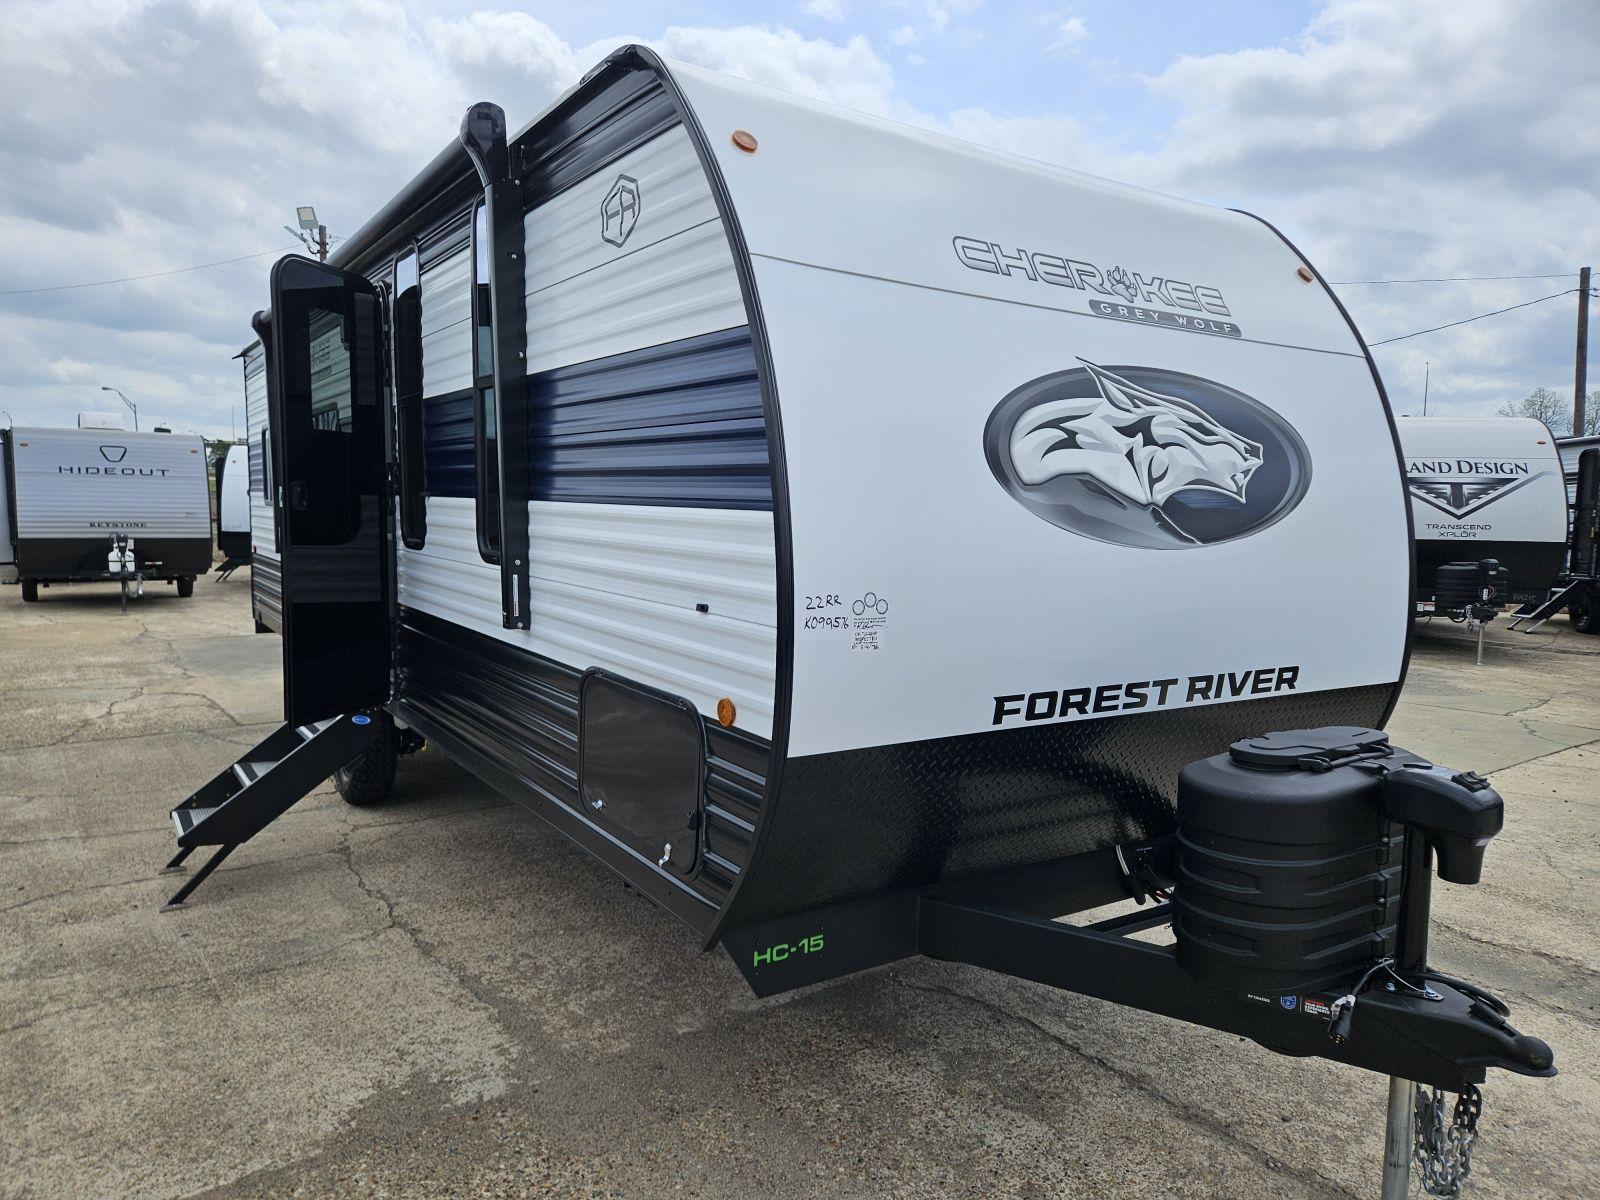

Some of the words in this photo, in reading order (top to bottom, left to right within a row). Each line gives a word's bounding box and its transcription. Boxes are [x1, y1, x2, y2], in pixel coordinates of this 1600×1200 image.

[1100, 302, 1160, 322] GREY
[1175, 315, 1232, 334] WOLF
[58, 465, 170, 477] HIDEOUT
[1406, 461, 1452, 474] AND
[1456, 460, 1529, 475] DESIGN
[89, 521, 147, 529] KEYSTONE
[1425, 523, 1492, 531] TRANSCEND
[805, 594, 842, 610] 22RR
[992, 678, 1179, 726] FOREST
[1186, 665, 1300, 703] RIVER
[753, 934, 824, 967] HC-15
